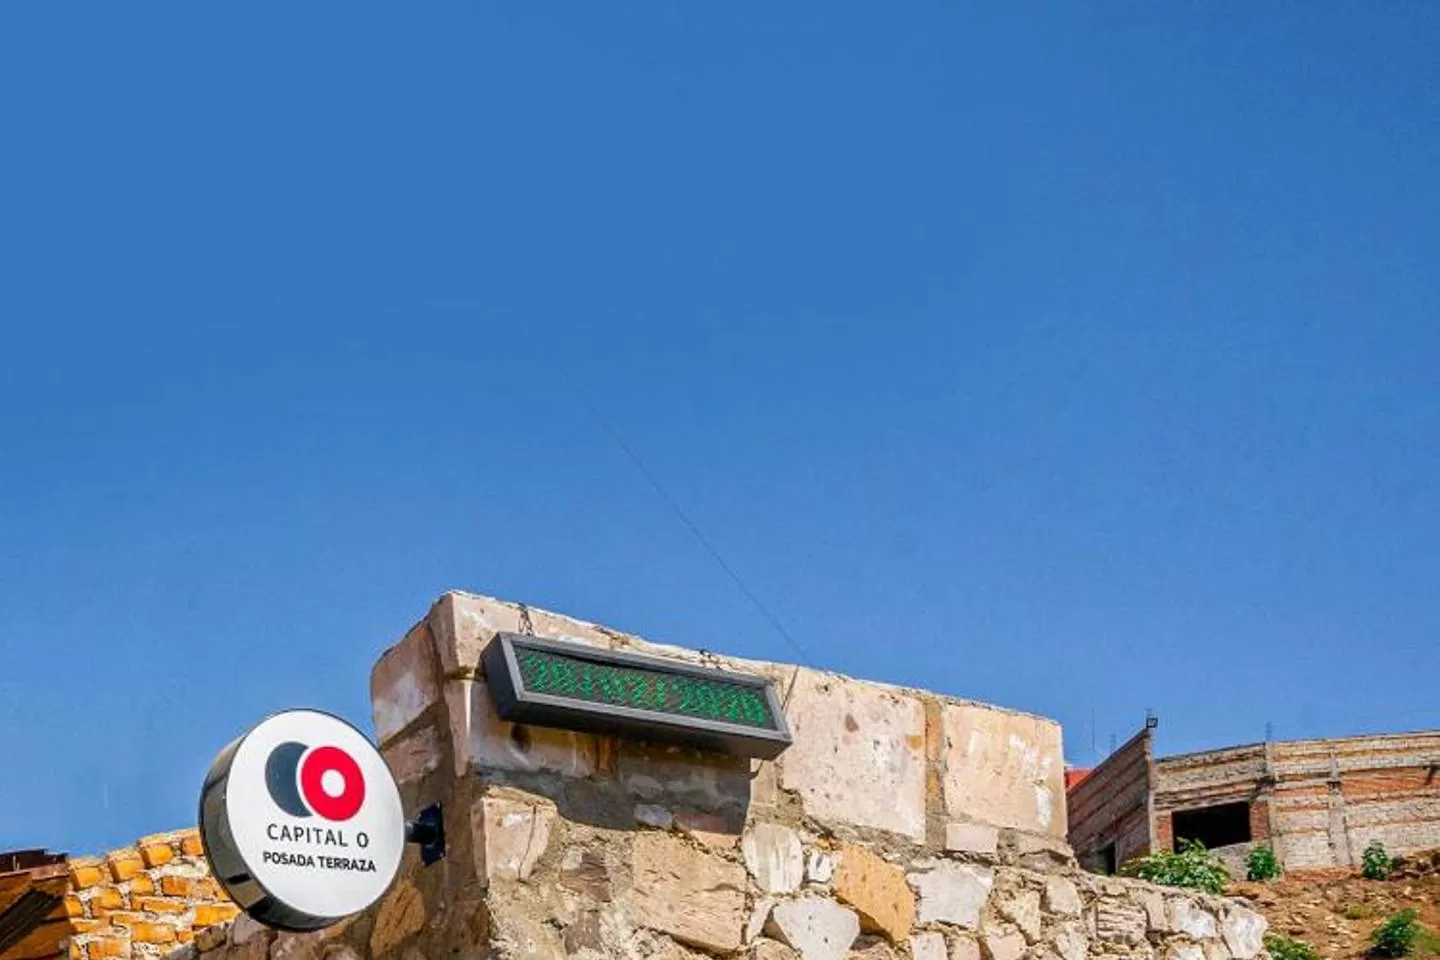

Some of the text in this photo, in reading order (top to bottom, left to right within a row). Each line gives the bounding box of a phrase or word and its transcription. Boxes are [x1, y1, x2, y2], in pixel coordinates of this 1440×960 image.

[266, 823, 369, 848] CAPITAL O
[262, 851, 376, 872] POSADA TERRAZA
